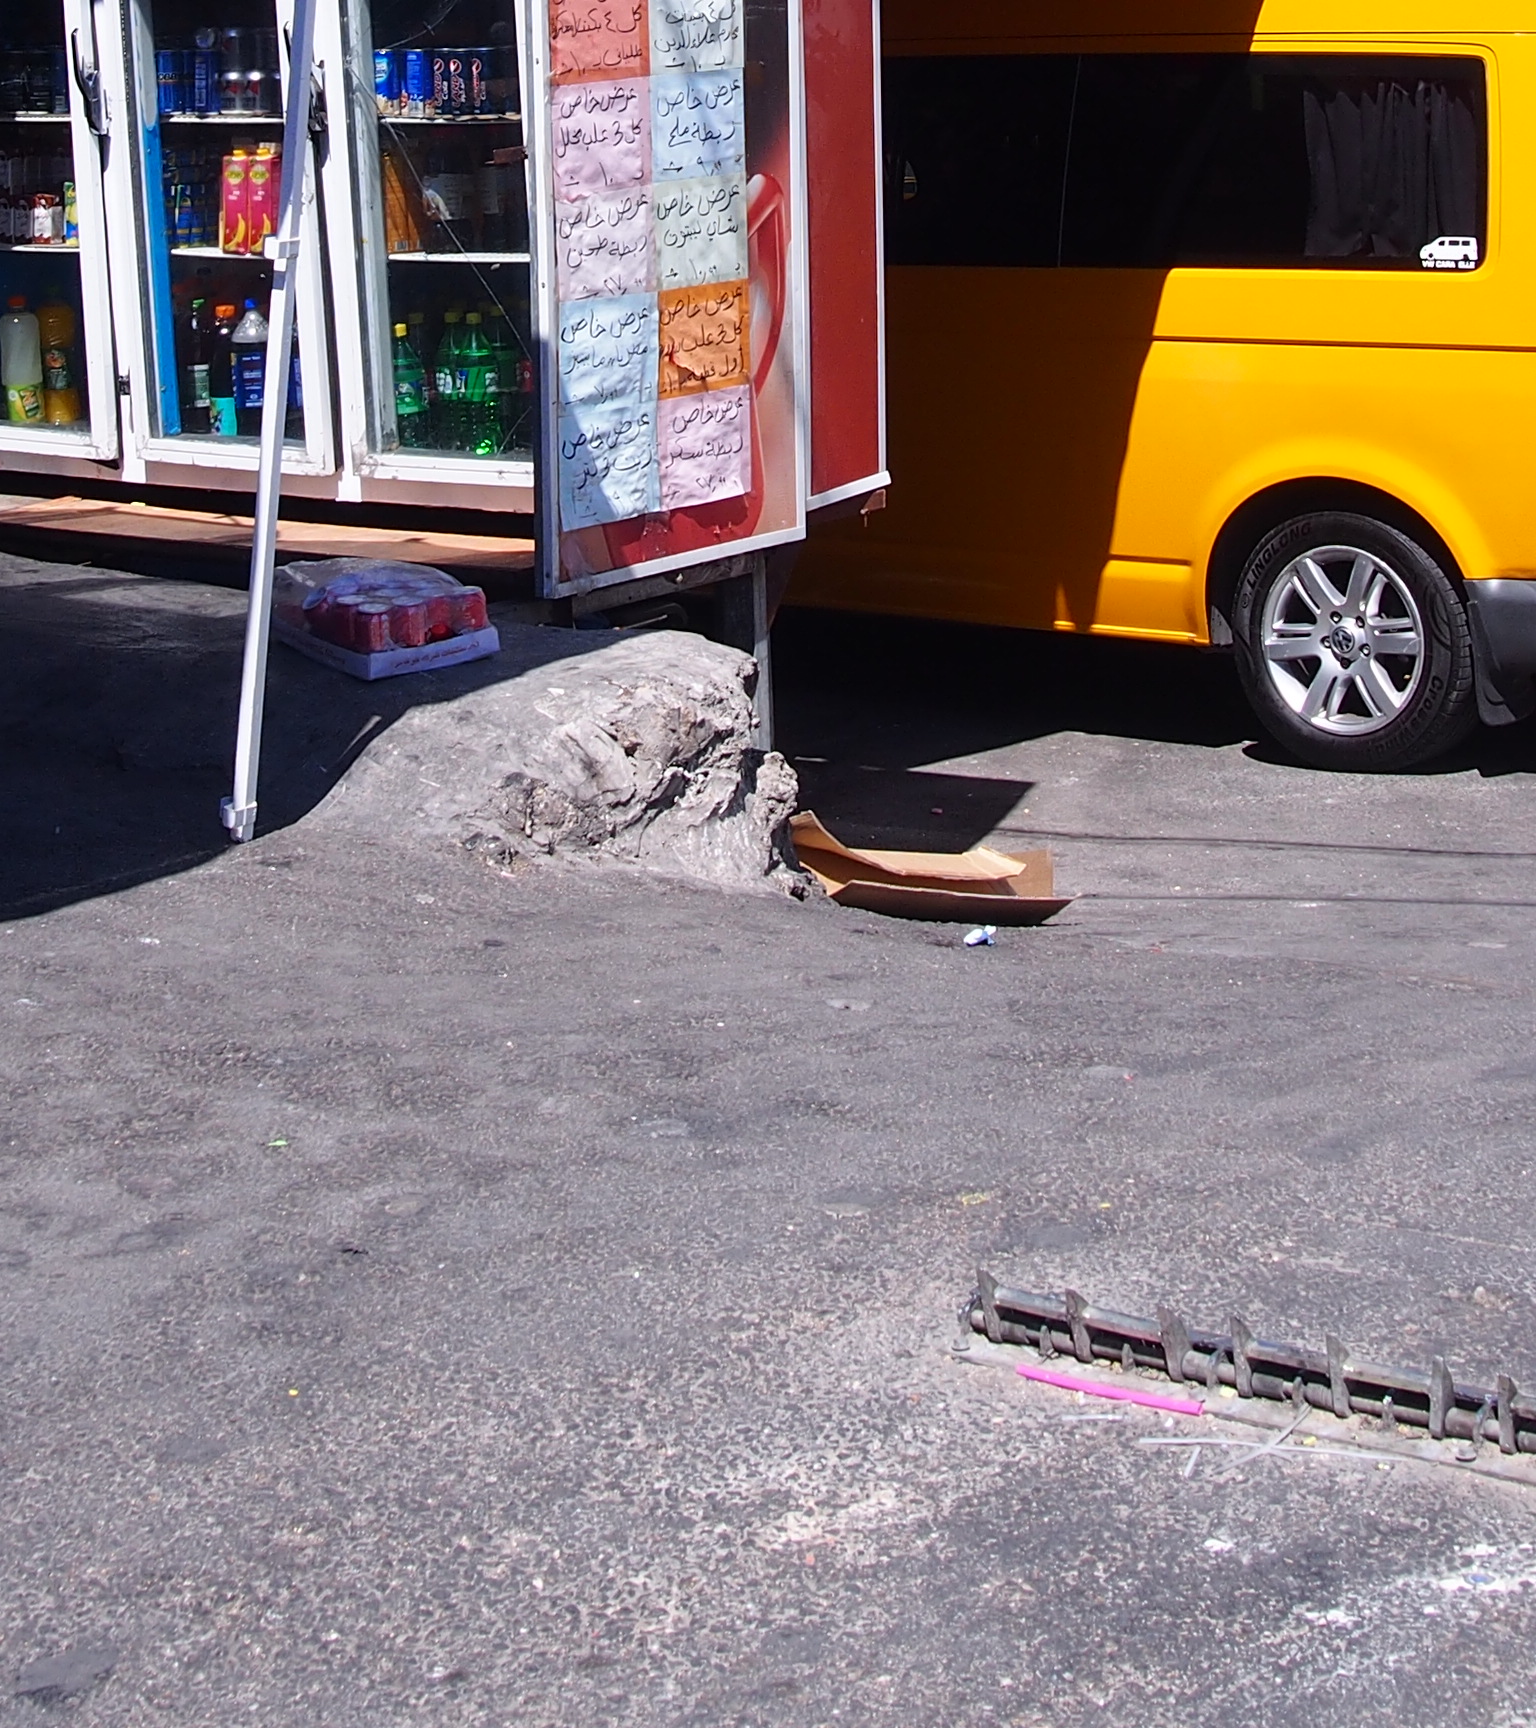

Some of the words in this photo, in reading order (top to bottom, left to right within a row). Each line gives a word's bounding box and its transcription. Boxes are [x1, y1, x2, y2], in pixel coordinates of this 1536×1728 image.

[560, 87, 600, 118] خاص
[657, 82, 702, 116] خاص
[559, 203, 605, 239] خاص
[657, 188, 694, 220] خاص
[561, 309, 606, 343] خاص
[660, 295, 700, 325] خاص
[673, 398, 714, 434] خاص
[562, 424, 604, 459] خاص
